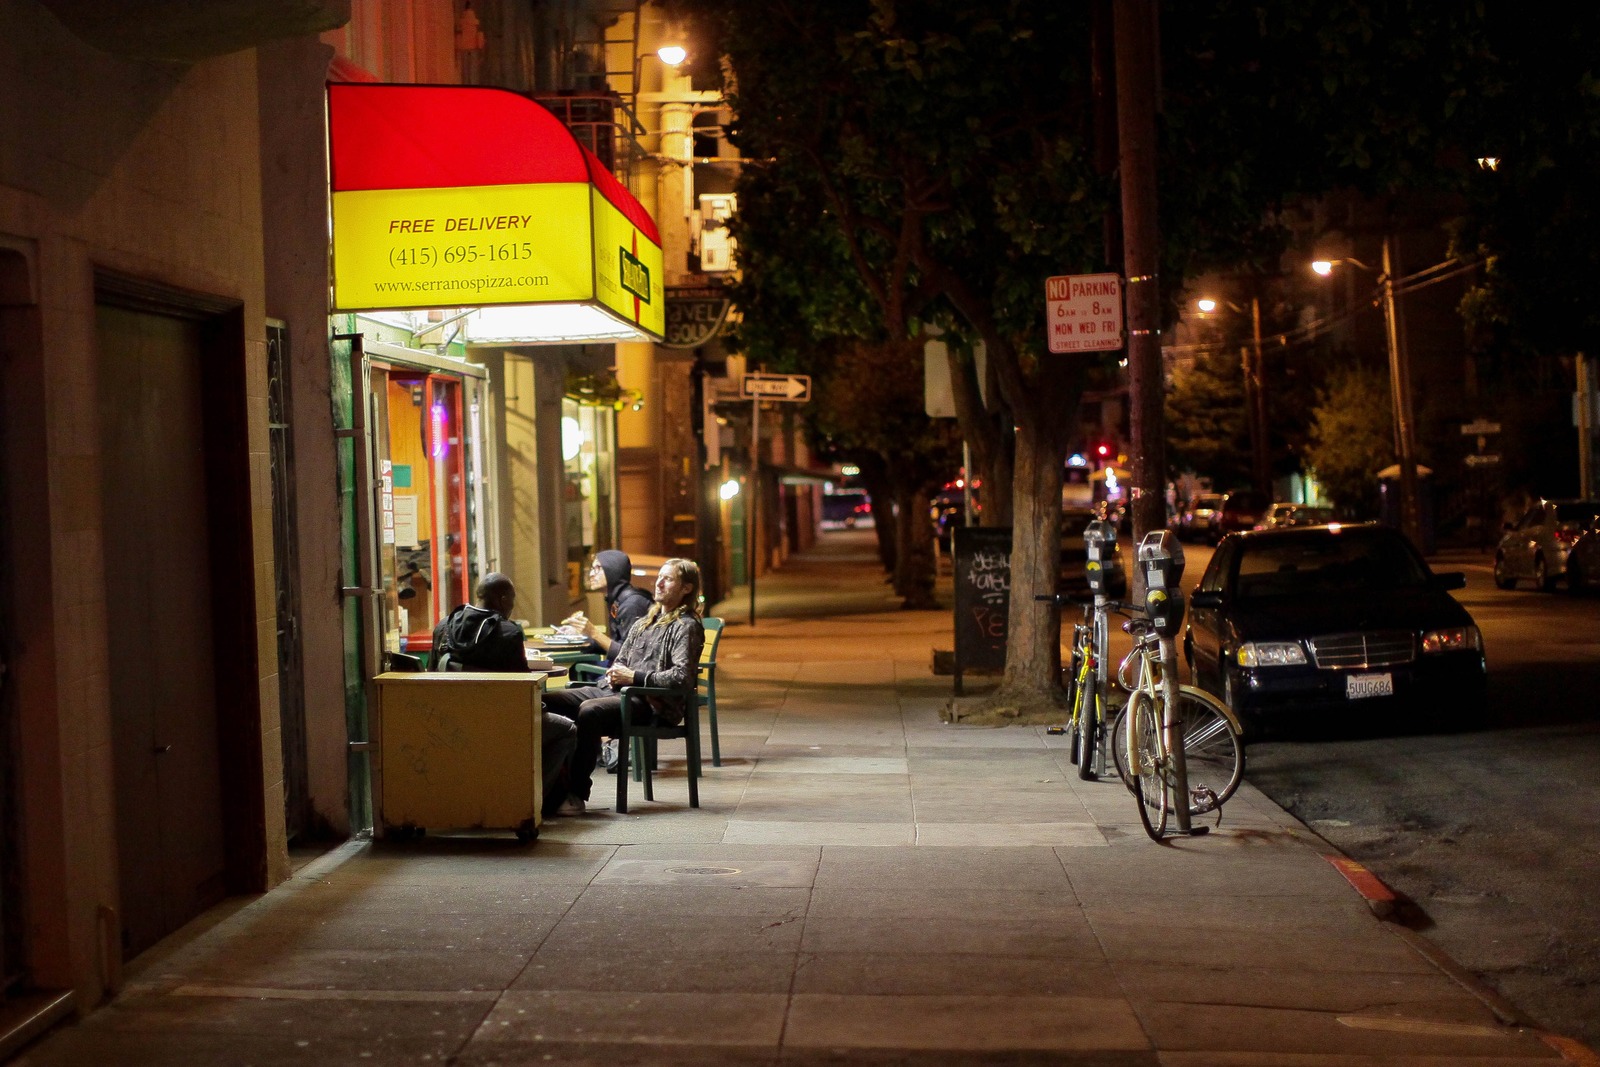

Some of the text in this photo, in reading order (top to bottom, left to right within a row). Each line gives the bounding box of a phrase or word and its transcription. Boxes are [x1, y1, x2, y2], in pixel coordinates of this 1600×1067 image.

[388, 215, 532, 234] FREE DELIVERY
[389, 242, 532, 269] (415) 695-1615
[374, 274, 549, 293] www.serranospizza.com
[1049, 279, 1116, 299] NO PARKING
[1055, 321, 1116, 335] MON WED FRI
[1056, 339, 1117, 349] STREET CLEANING
